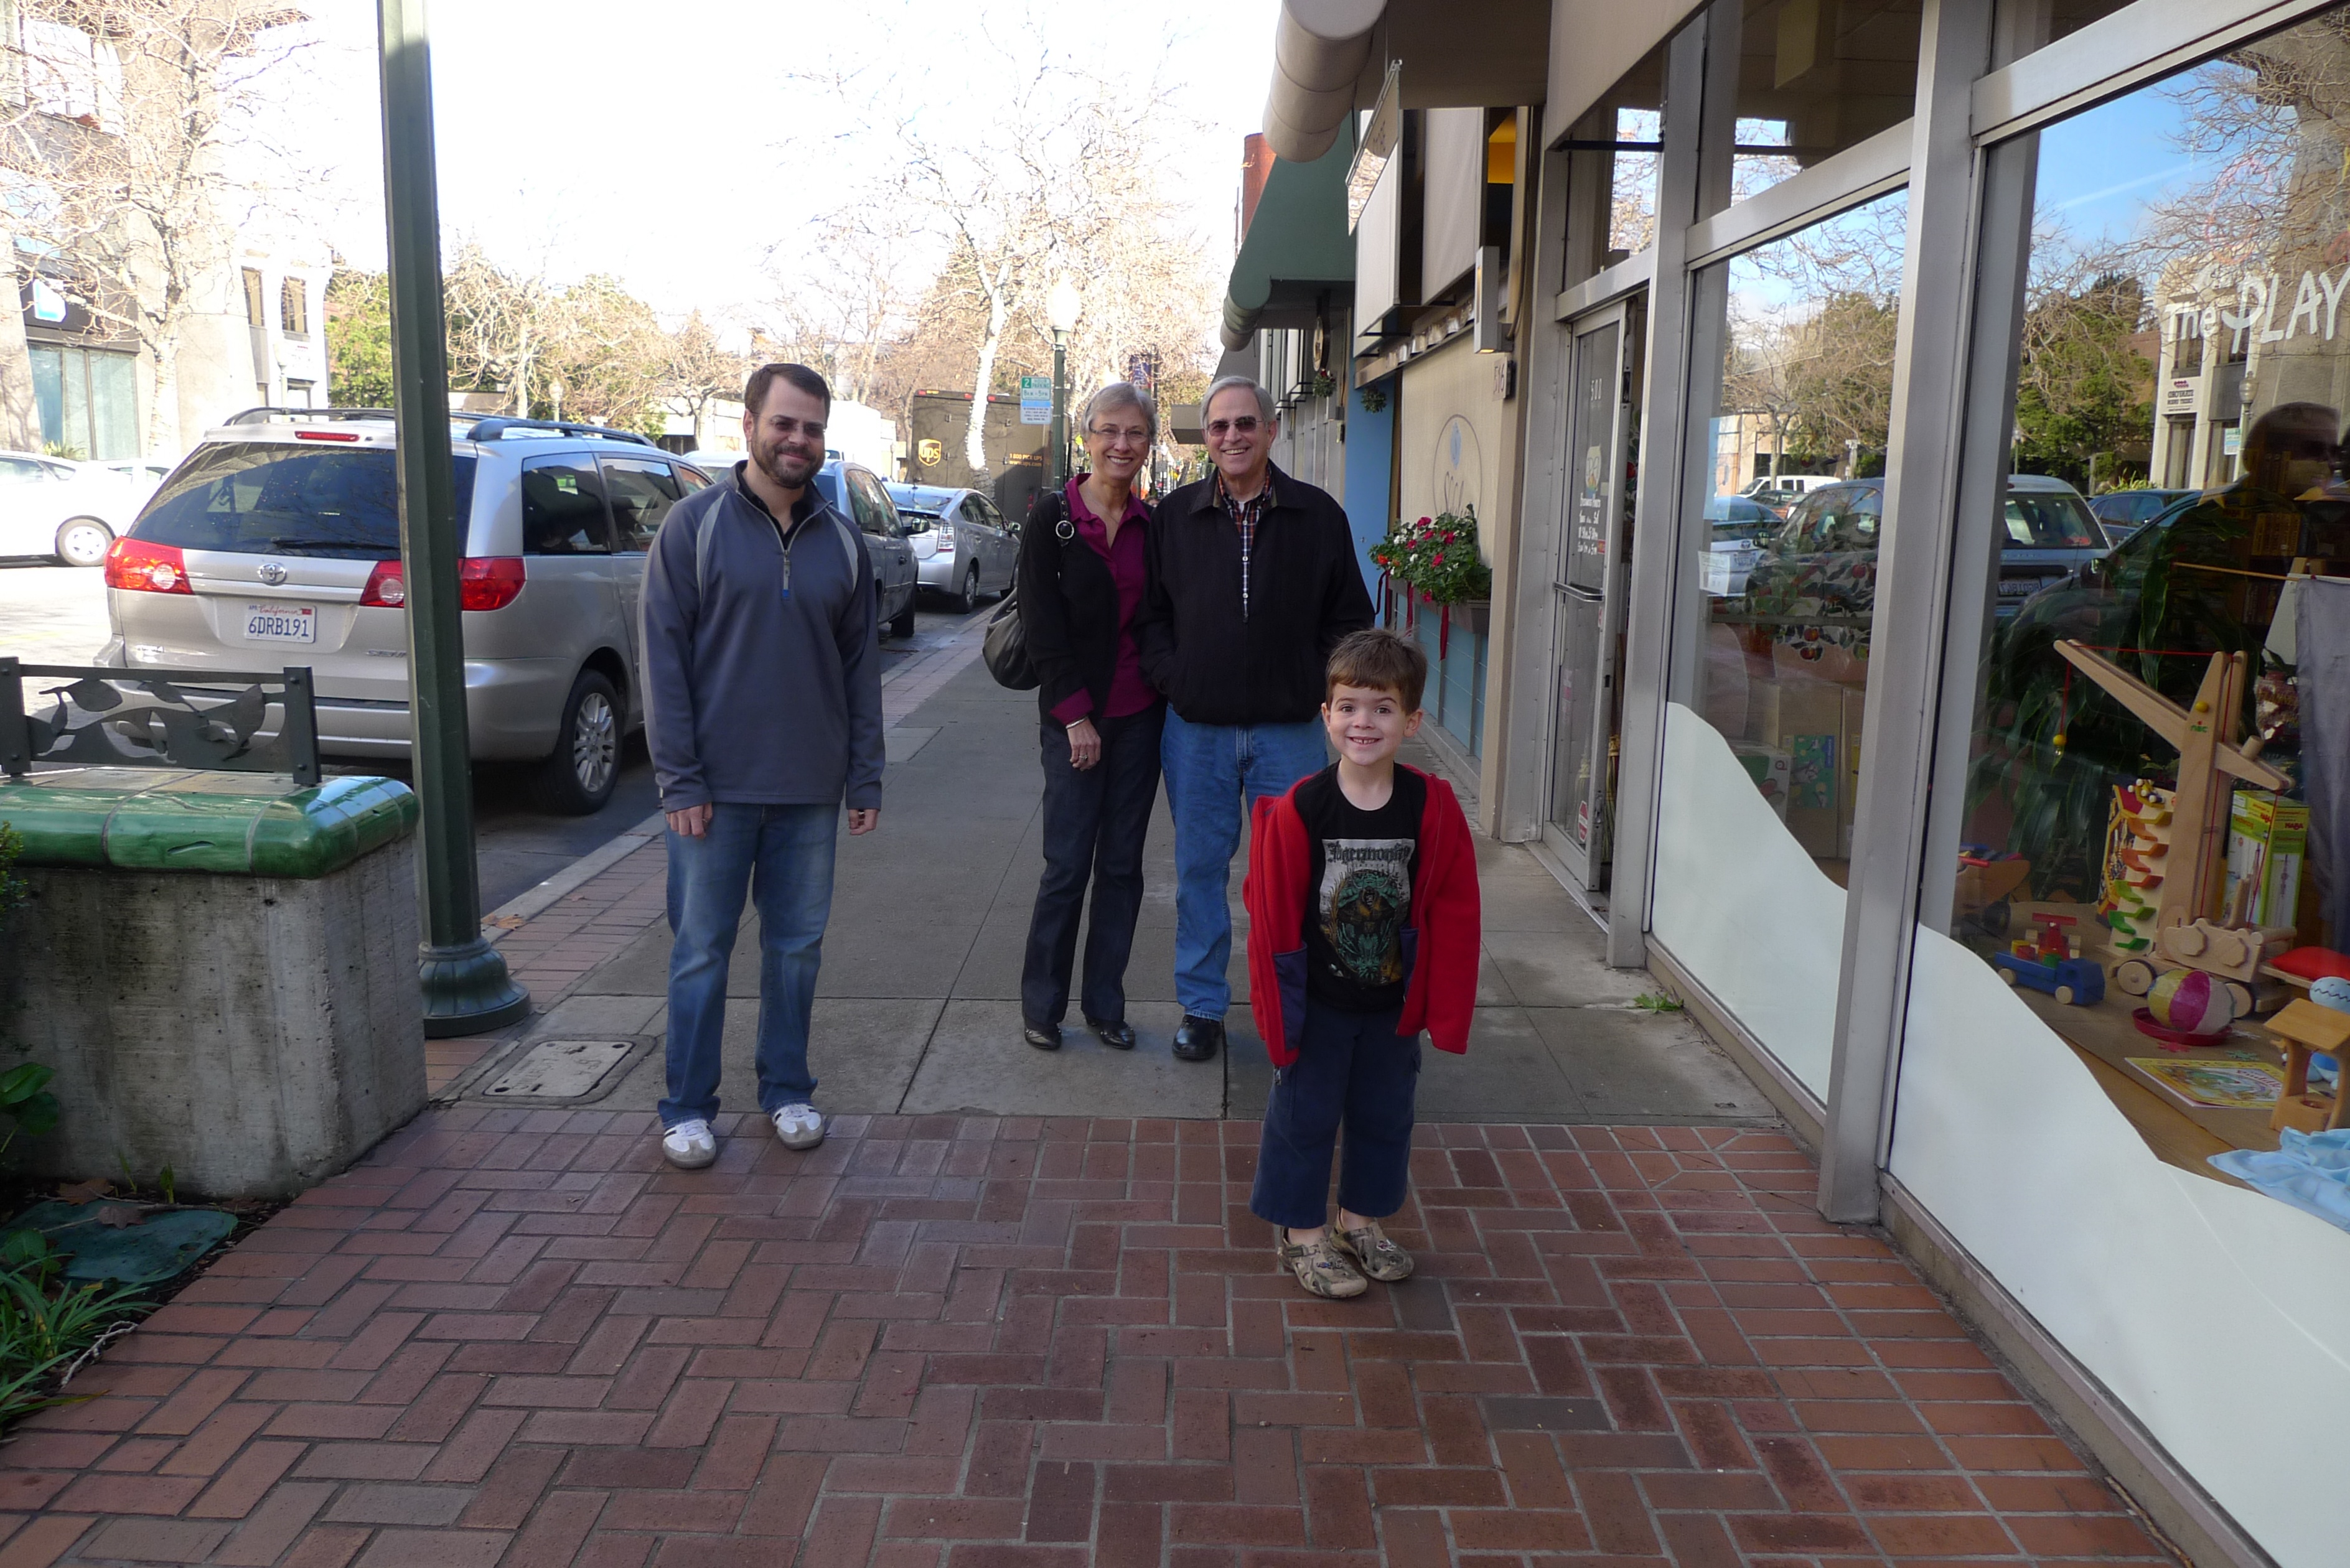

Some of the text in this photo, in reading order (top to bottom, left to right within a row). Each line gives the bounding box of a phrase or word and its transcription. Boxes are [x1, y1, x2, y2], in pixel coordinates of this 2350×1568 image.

[2164, 266, 2350, 354] The PLAY
[1024, 378, 1030, 388] 2
[1493, 363, 1505, 394] 516
[920, 447, 939, 462] ups
[248, 616, 309, 637] 6DRB191
